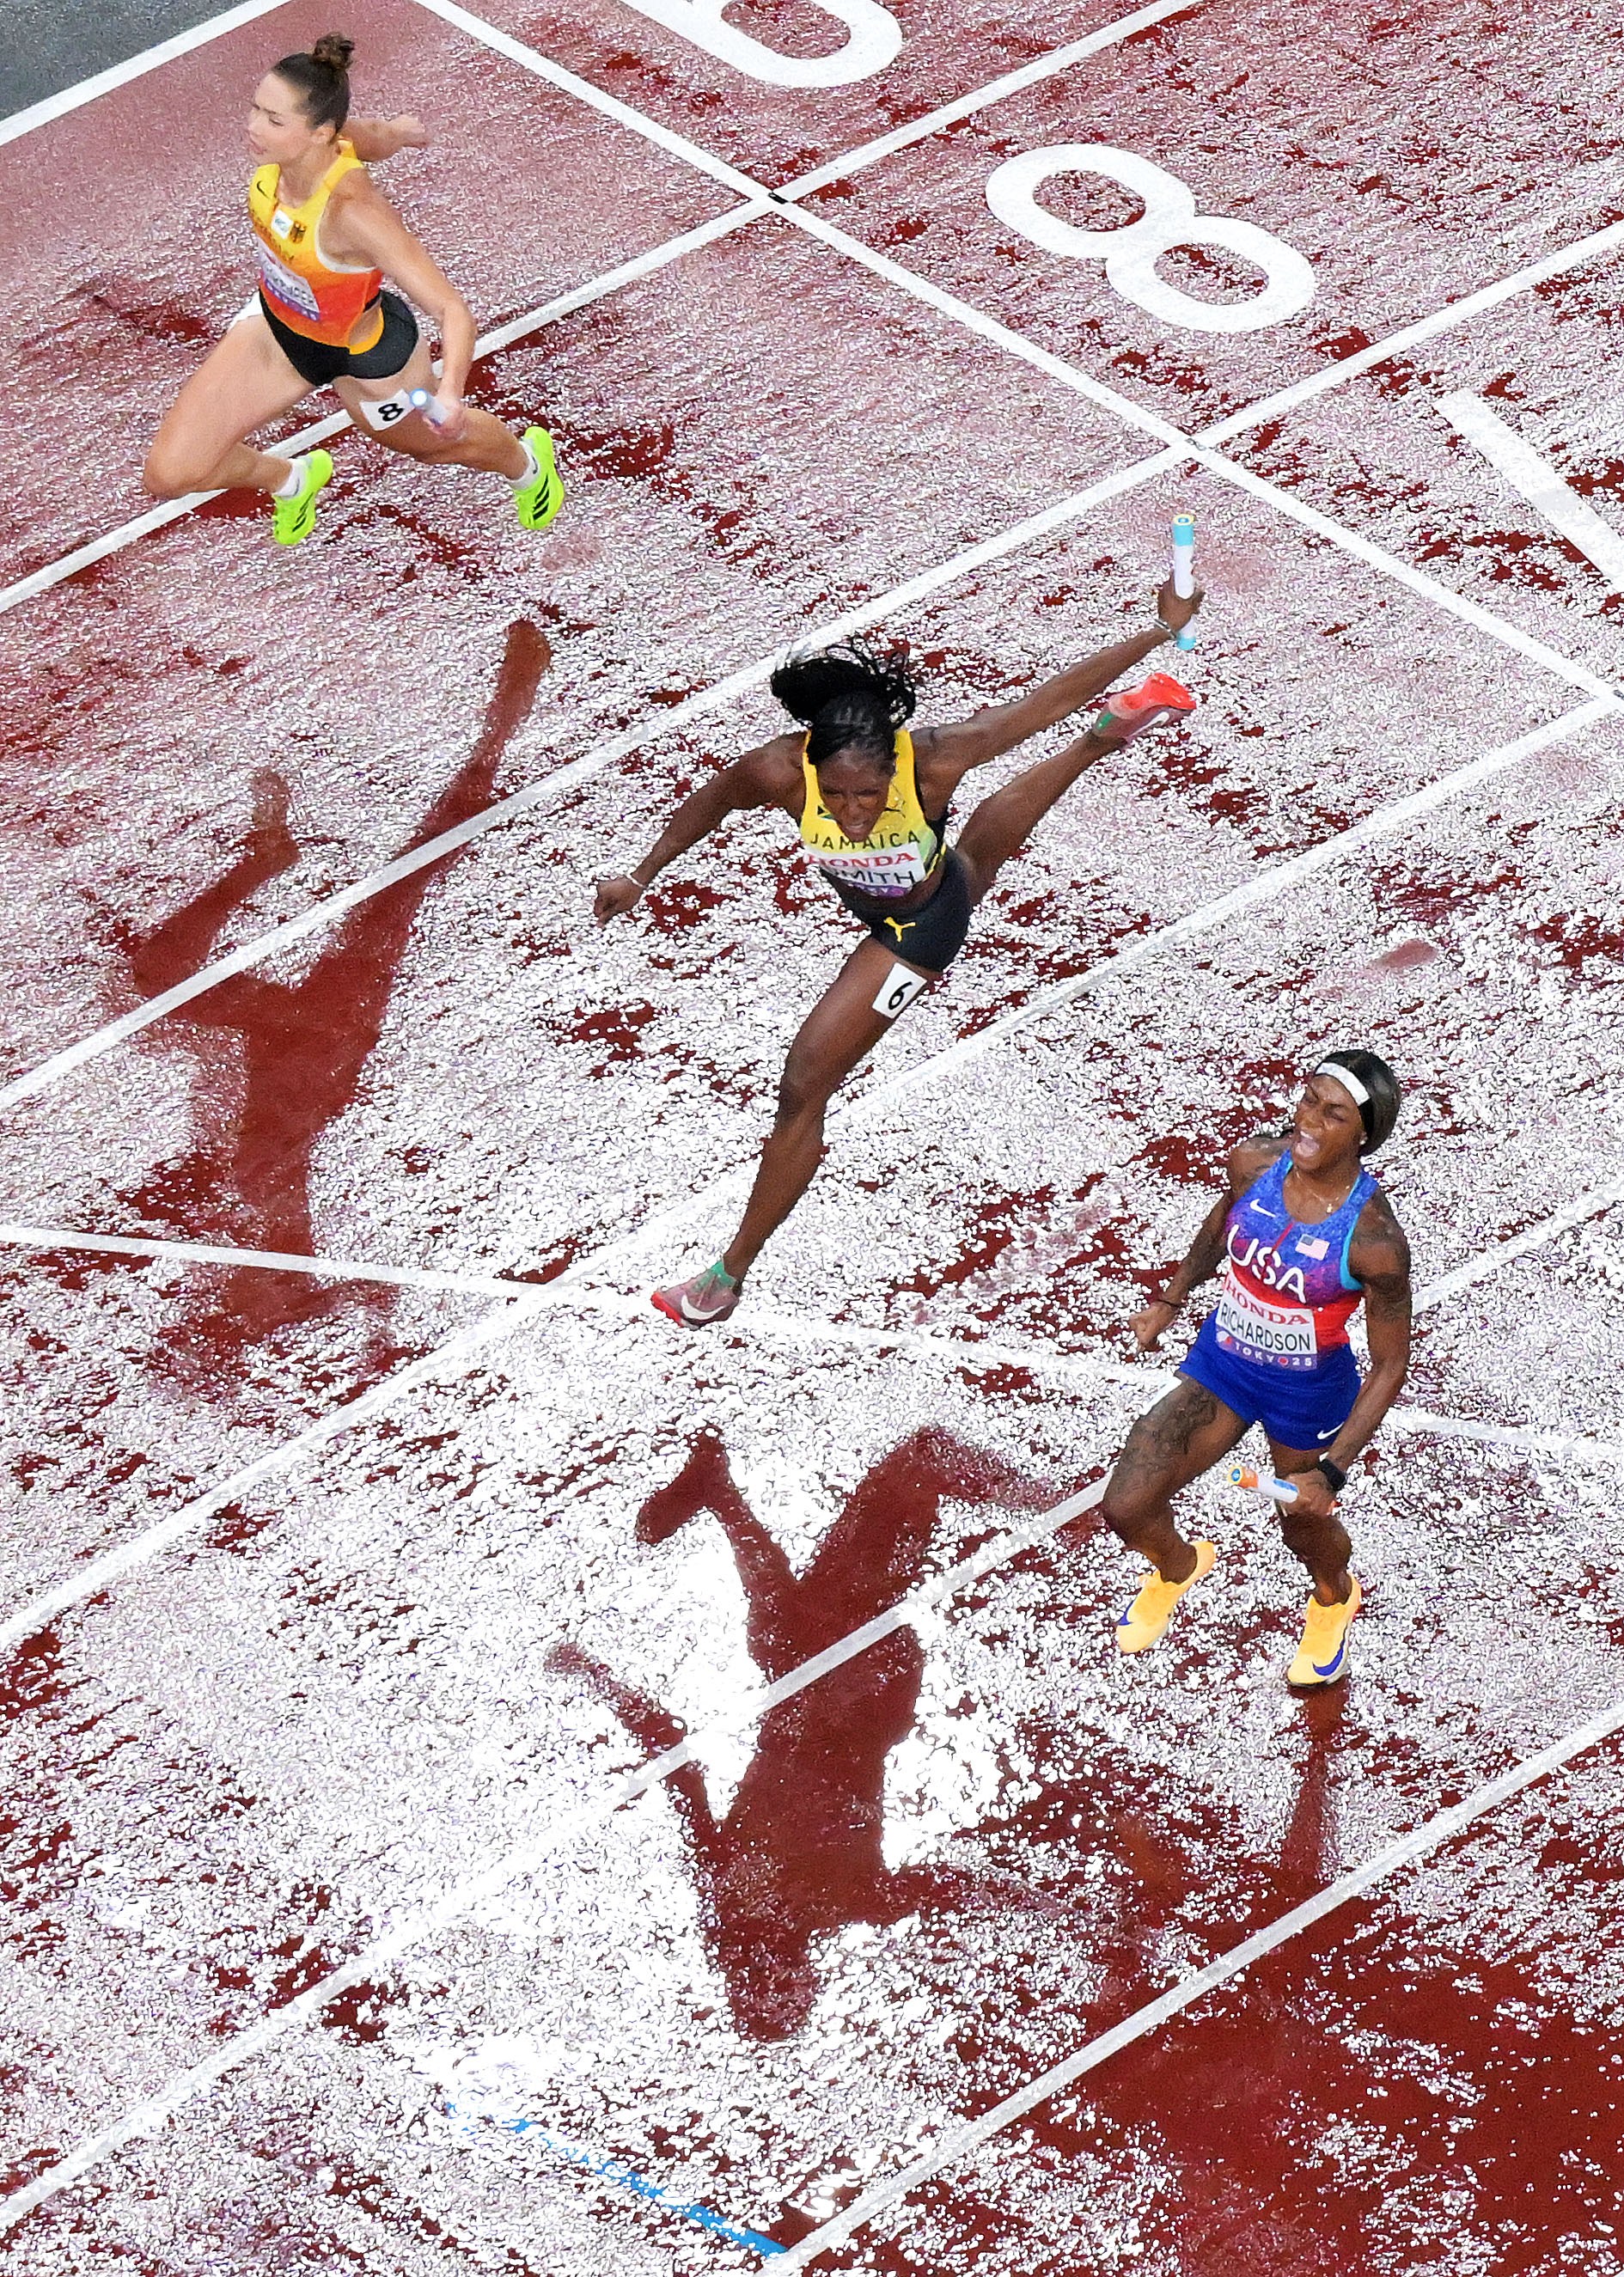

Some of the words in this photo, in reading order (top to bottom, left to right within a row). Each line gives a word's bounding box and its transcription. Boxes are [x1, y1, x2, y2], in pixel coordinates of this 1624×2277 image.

[986, 143, 1316, 333] 8
[378, 403, 405, 422] 8
[810, 830, 920, 850] JAMAICA
[808, 852, 917, 868] HONDA
[833, 870, 915, 885] MITH
[888, 981, 913, 1010] 6
[1227, 1224, 1306, 1303] USA
[1226, 1279, 1310, 1325] HONDA
[1221, 1303, 1311, 1352] RICHARDSON
